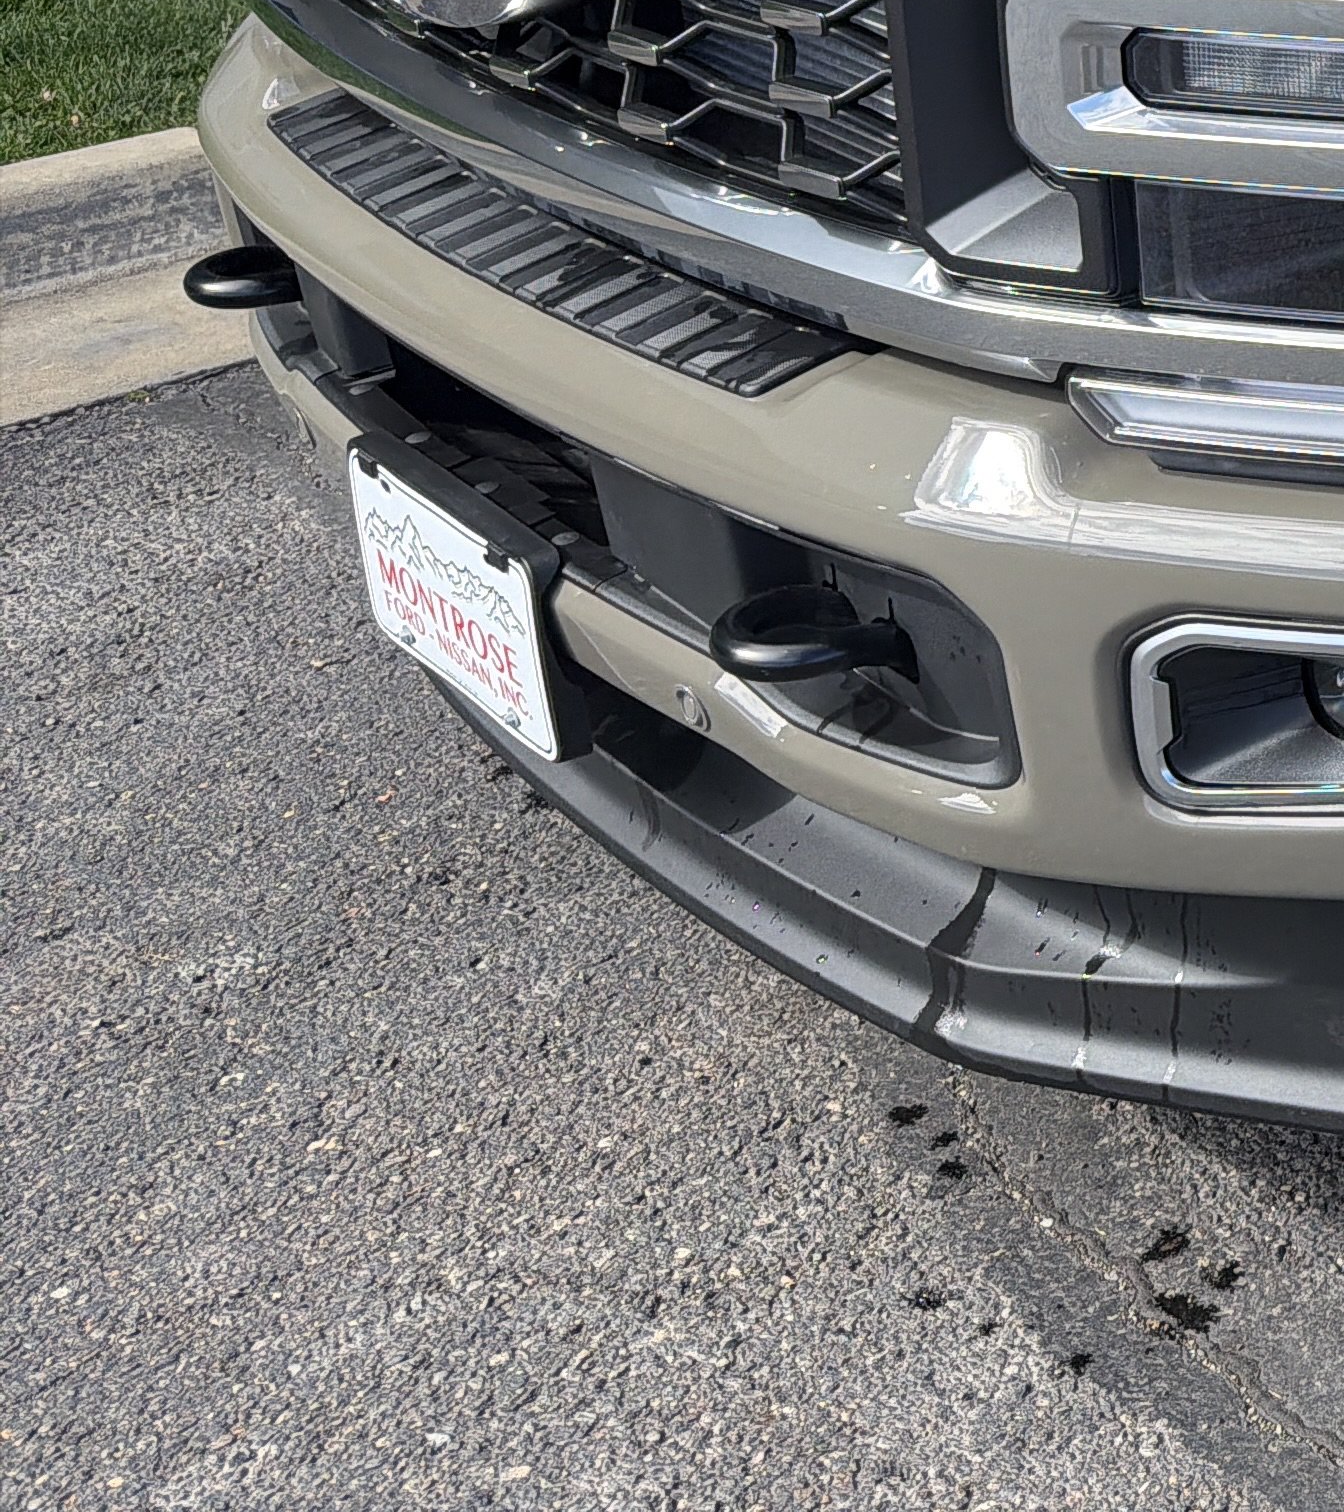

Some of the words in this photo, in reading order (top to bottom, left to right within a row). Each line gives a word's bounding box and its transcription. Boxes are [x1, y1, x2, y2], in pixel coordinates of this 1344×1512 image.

[376, 549, 523, 688] MONTROSE
[384, 590, 426, 637] FORD
[497, 675, 535, 721] INC.
